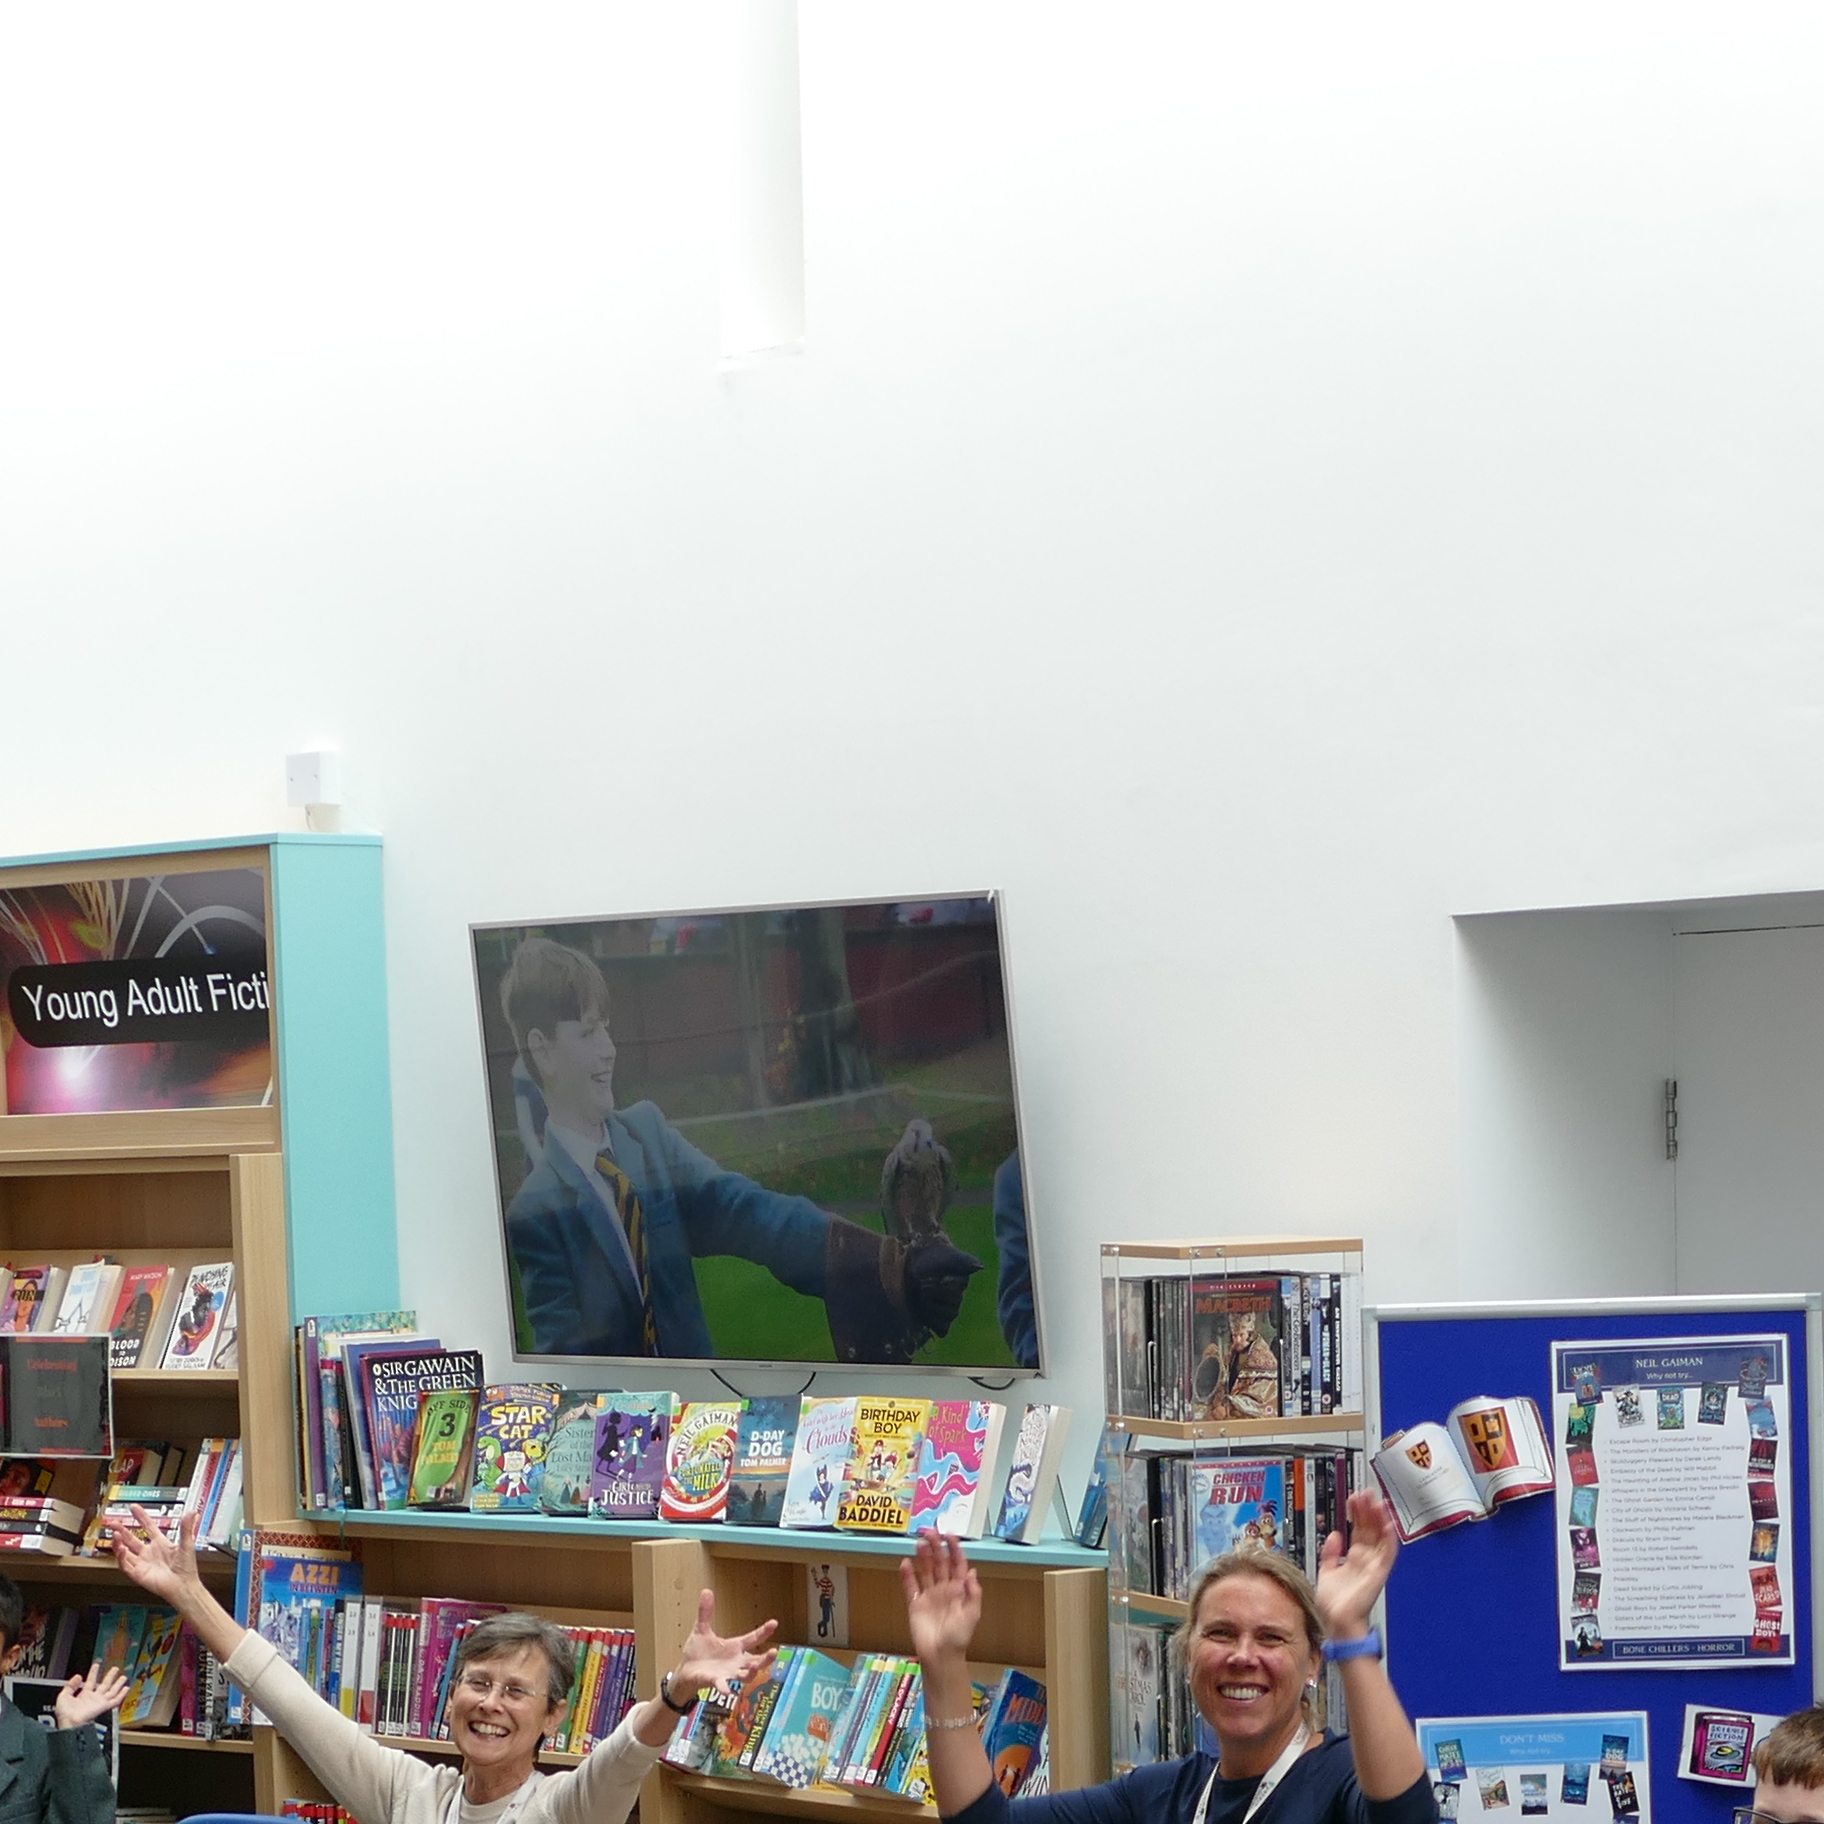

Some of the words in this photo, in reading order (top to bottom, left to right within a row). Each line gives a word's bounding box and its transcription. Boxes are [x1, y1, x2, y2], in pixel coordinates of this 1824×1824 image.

[21, 984, 119, 1028] Young
[127, 976, 203, 1016] Adult
[206, 971, 270, 1012] Ficti
[1195, 1296, 1273, 1314] MACBETH
[27, 1359, 79, 1373] Celebrating
[383, 1362, 404, 1377] SIR
[404, 1356, 475, 1376] GAWAIN
[1636, 1359, 1658, 1368] NEIL
[1661, 1357, 1703, 1368] GAIMAN
[387, 1379, 416, 1394] THE
[419, 1373, 476, 1390] GREEN
[1646, 1372, 1663, 1380] Why
[33, 1416, 69, 1428] Authors
[491, 1406, 547, 1425] STAR
[861, 1409, 921, 1423] BIRTHDAY
[942, 1407, 964, 1424] Kind
[439, 1413, 455, 1437] 3
[499, 1425, 534, 1439] CAT
[874, 1423, 902, 1434] BOY
[677, 1427, 696, 1456] NEIL
[695, 1412, 736, 1430] GAIMAN
[751, 1430, 785, 1442] D-DAY
[802, 1427, 851, 1454] Clouds
[929, 1425, 939, 1438] of
[939, 1426, 967, 1446] Spark
[551, 1451, 574, 1463] Lost
[748, 1442, 783, 1457] DOG
[740, 1459, 758, 1467] TOM
[759, 1457, 786, 1466] PALMER
[693, 1473, 718, 1491] MILK
[1213, 1471, 1266, 1485] CHICKEN
[602, 1489, 654, 1506] JUSTICE
[856, 1495, 892, 1507] DAVID
[1210, 1484, 1264, 1505] RUN
[839, 1507, 904, 1525] BADDIEL
[290, 1563, 341, 1585] AZZI
[299, 1584, 339, 1594] BETWEEN
[1623, 1646, 1646, 1655] BONE
[1649, 1644, 1690, 1653] CHILLERS
[1697, 1643, 1735, 1652] HORROR
[811, 1682, 843, 1711] BOY
[1499, 1735, 1535, 1745] DON'T
[1538, 1734, 1565, 1743] MISS
[1710, 1733, 1744, 1741] FICTION
